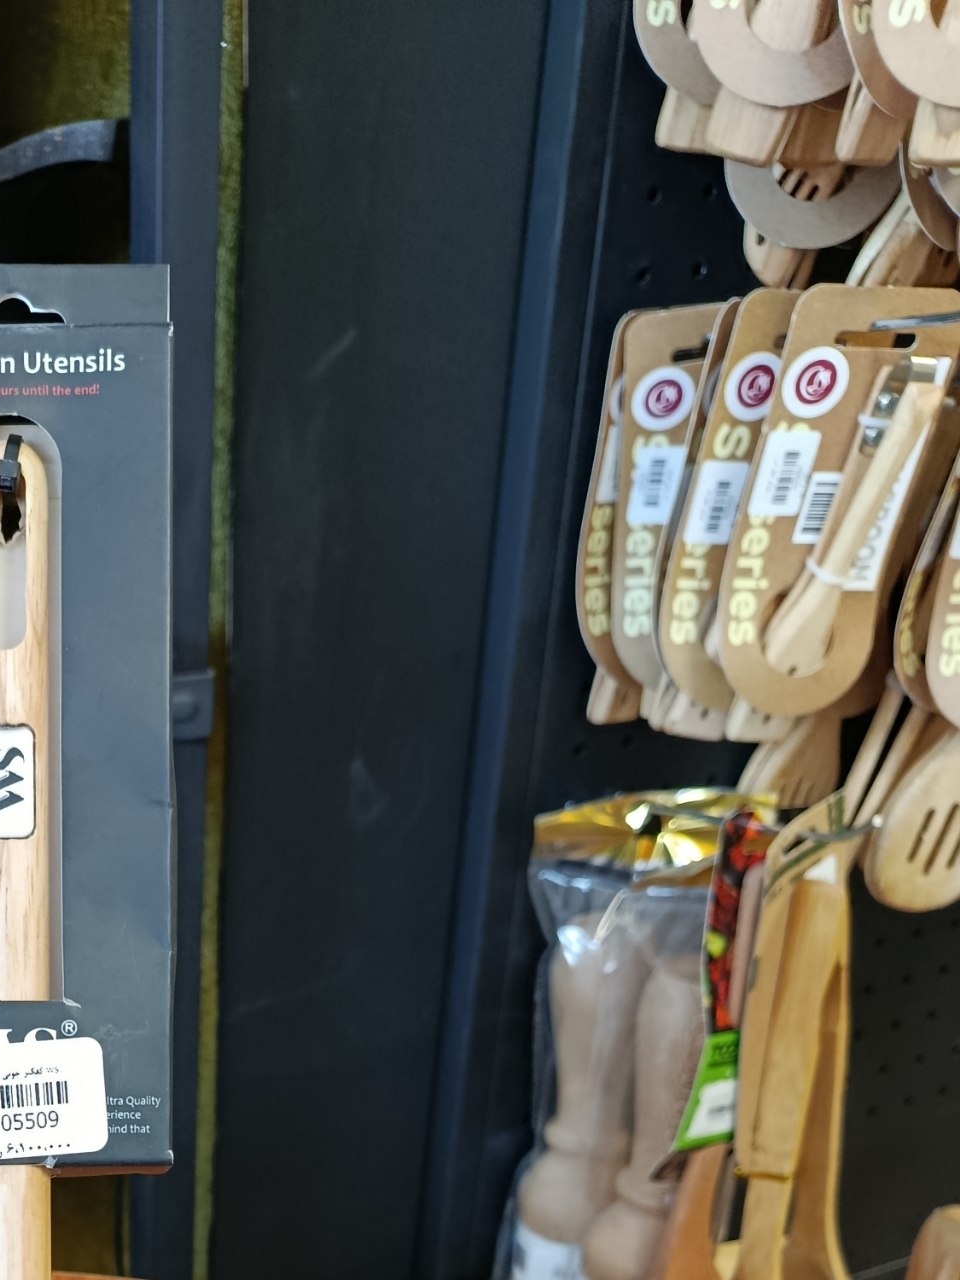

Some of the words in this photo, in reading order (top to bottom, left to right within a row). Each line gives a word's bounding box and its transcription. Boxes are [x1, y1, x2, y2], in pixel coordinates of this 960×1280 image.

[24, 348, 126, 374] Utensils
[22, 384, 49, 396] until
[52, 384, 72, 395] the
[74, 383, 100, 395] end!
[106, 1095, 124, 1106] ltra
[126, 1095, 161, 1108] Quality
[106, 1109, 141, 1120] erience
[130, 1124, 151, 1134] that
